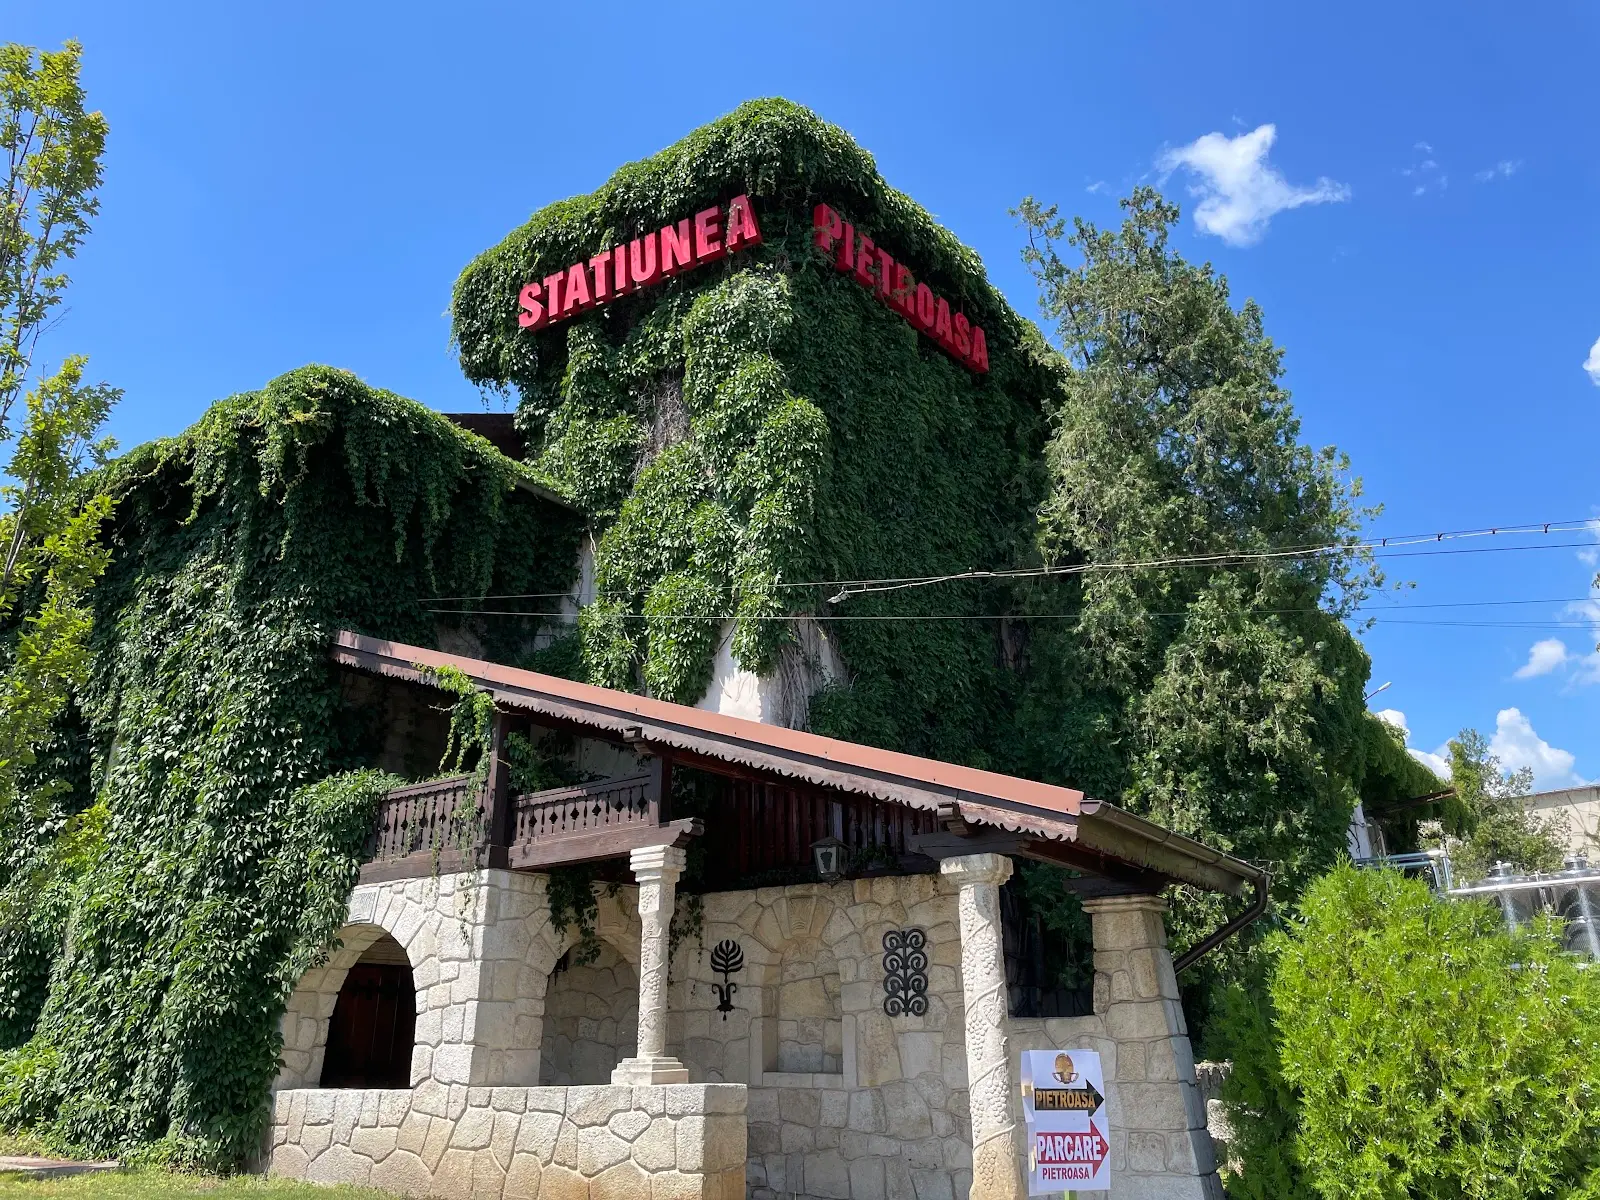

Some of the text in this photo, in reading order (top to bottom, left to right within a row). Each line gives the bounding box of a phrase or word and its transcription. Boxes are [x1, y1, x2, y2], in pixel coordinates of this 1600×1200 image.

[518, 193, 760, 331] STATIUNEA
[813, 202, 990, 373] PIETROASA
[1035, 1090, 1096, 1108] PIETROASA
[1036, 1135, 1102, 1161] PARCARE
[1042, 1167, 1090, 1180] PIETROASA
